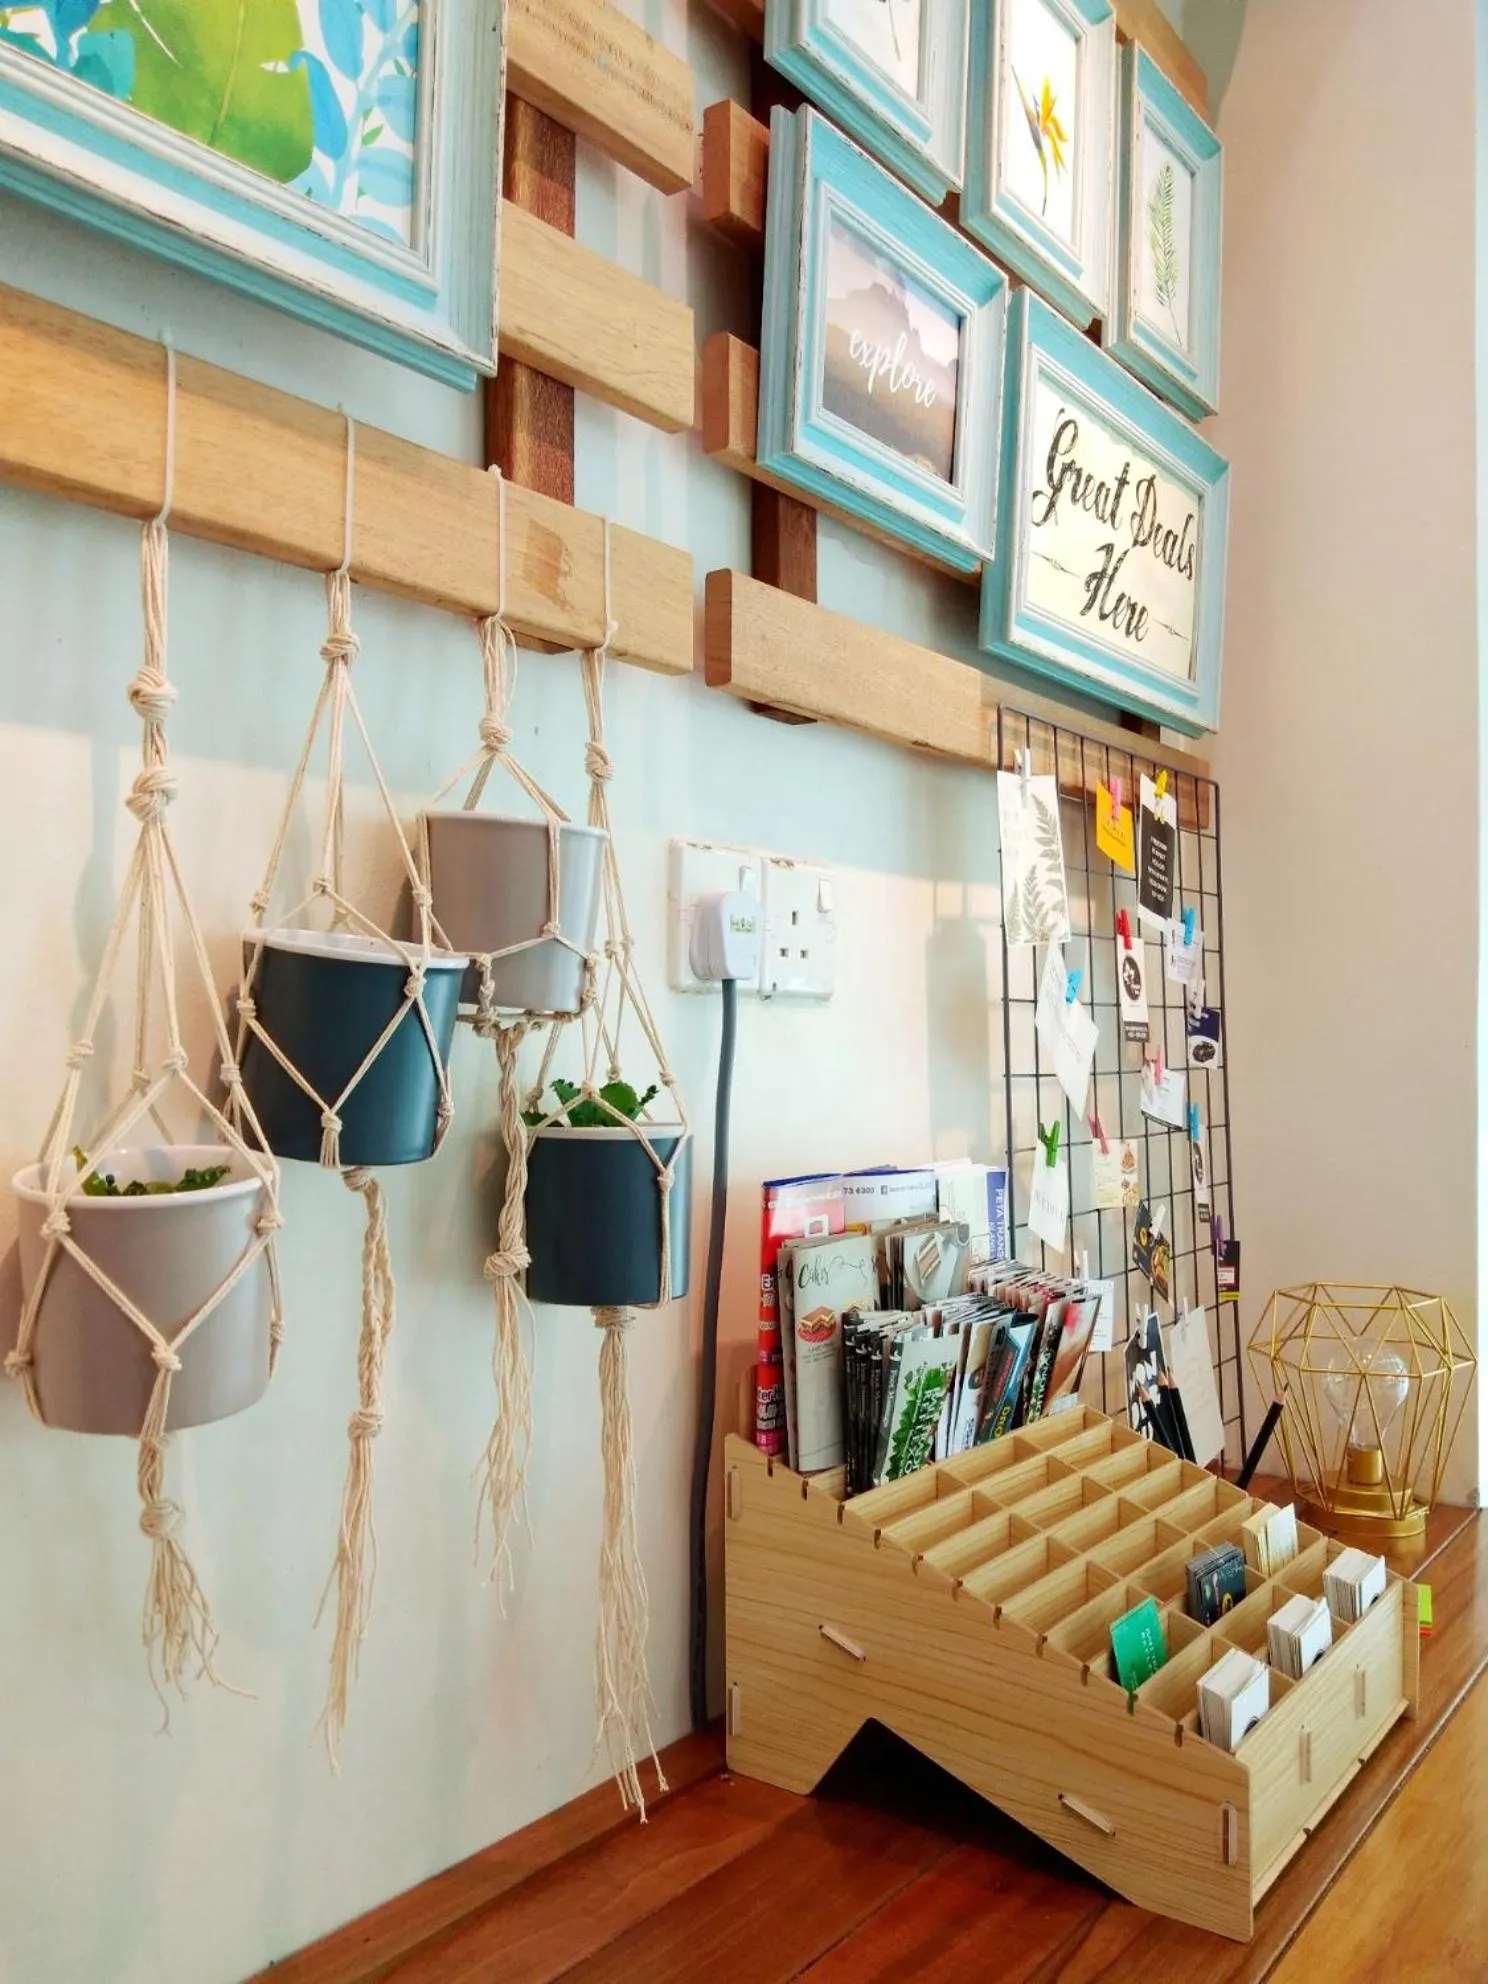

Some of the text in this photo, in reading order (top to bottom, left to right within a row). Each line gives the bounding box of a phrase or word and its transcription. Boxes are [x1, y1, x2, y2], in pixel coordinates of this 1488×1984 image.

[849, 327, 937, 408] explore
[1032, 408, 1195, 581] Great Deals
[1080, 543, 1149, 642] Here
